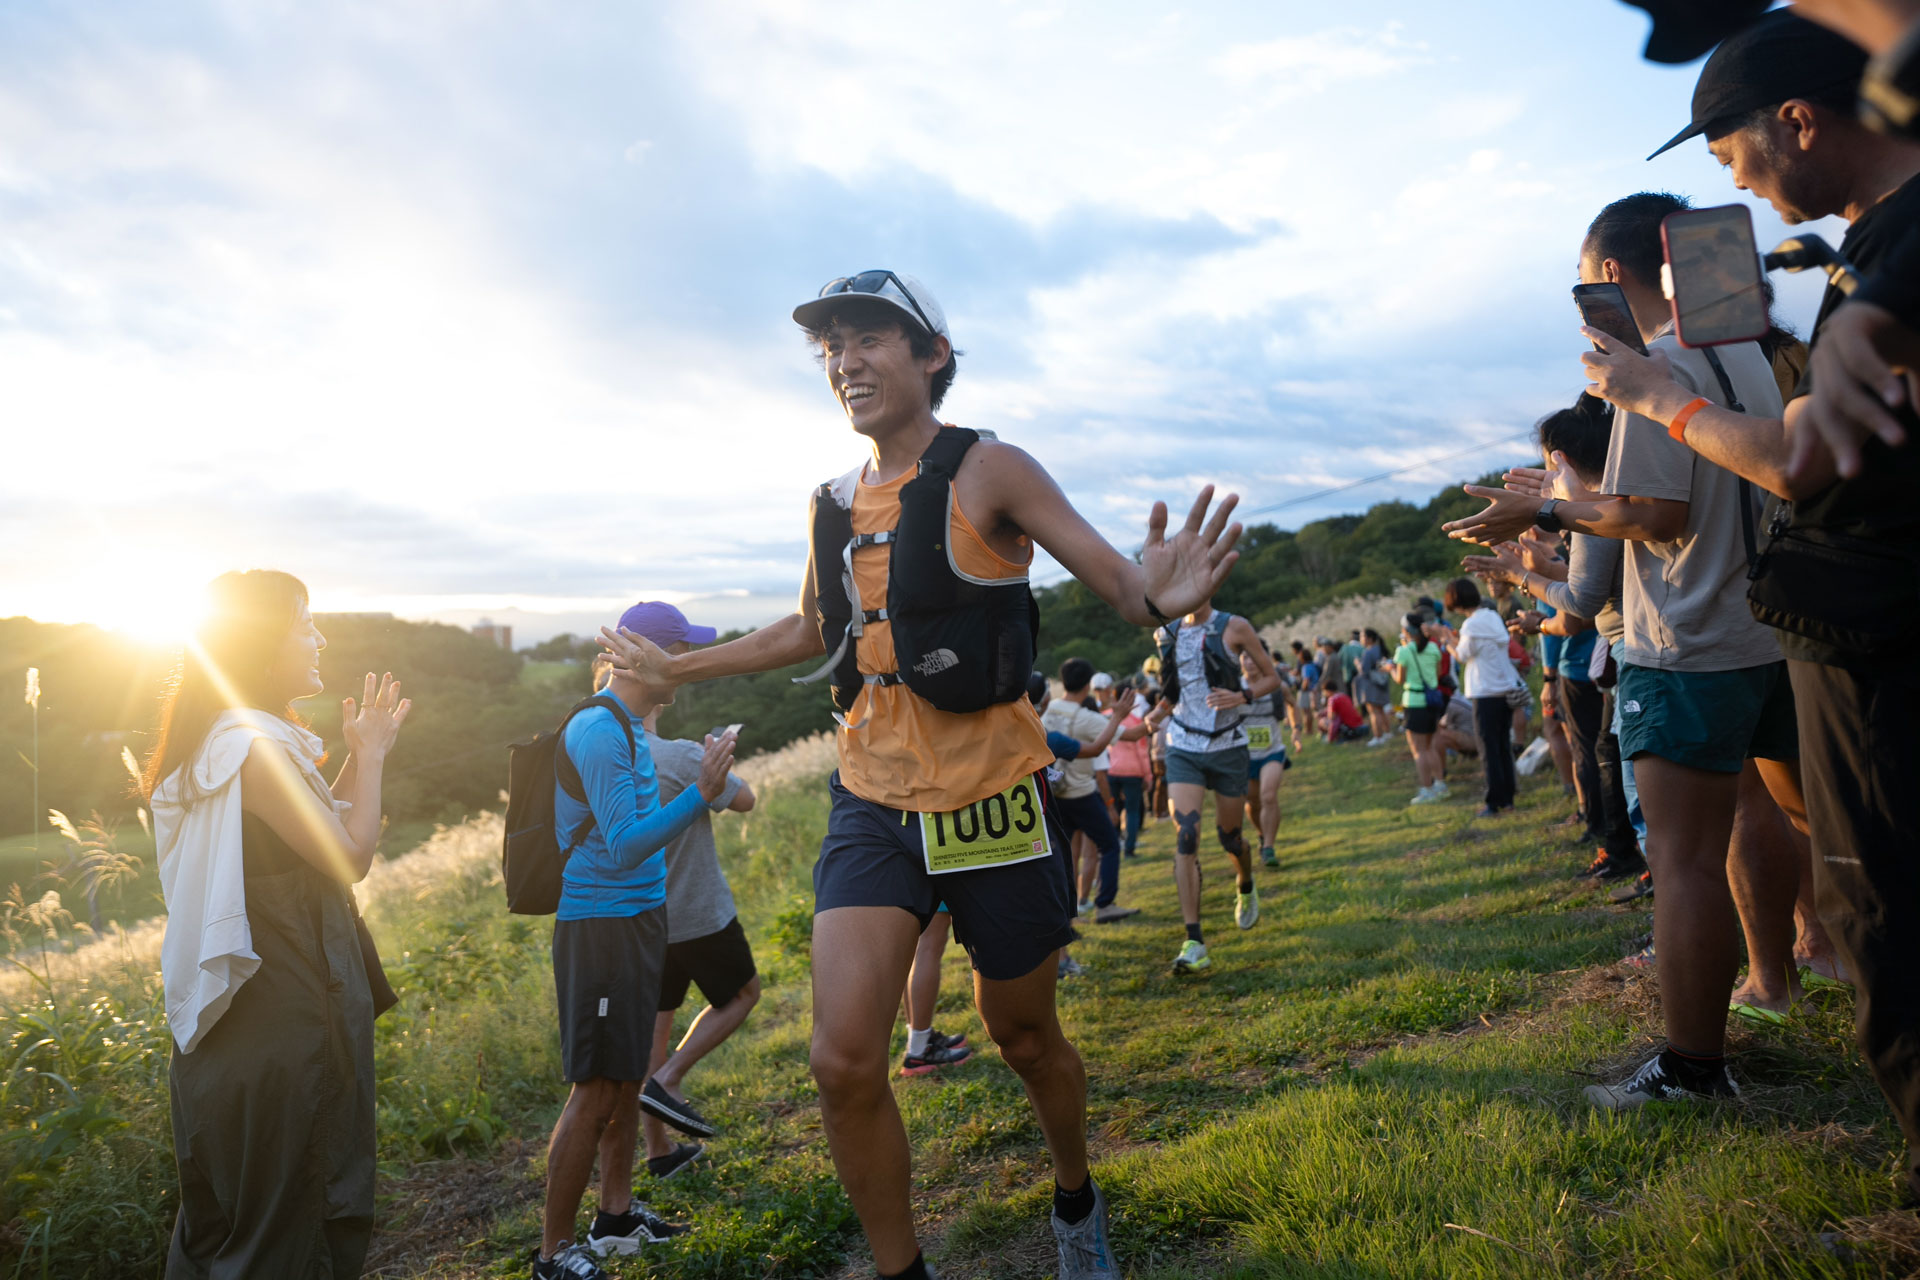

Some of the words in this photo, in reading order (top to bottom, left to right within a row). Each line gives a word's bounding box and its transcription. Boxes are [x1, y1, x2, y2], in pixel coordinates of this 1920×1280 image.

[922, 650, 939, 661] THE
[913, 658, 944, 672] NORTH
[923, 665, 945, 677] FACE
[934, 784, 1036, 847] 1003
[968, 847, 1000, 856] MOUNTAINS
